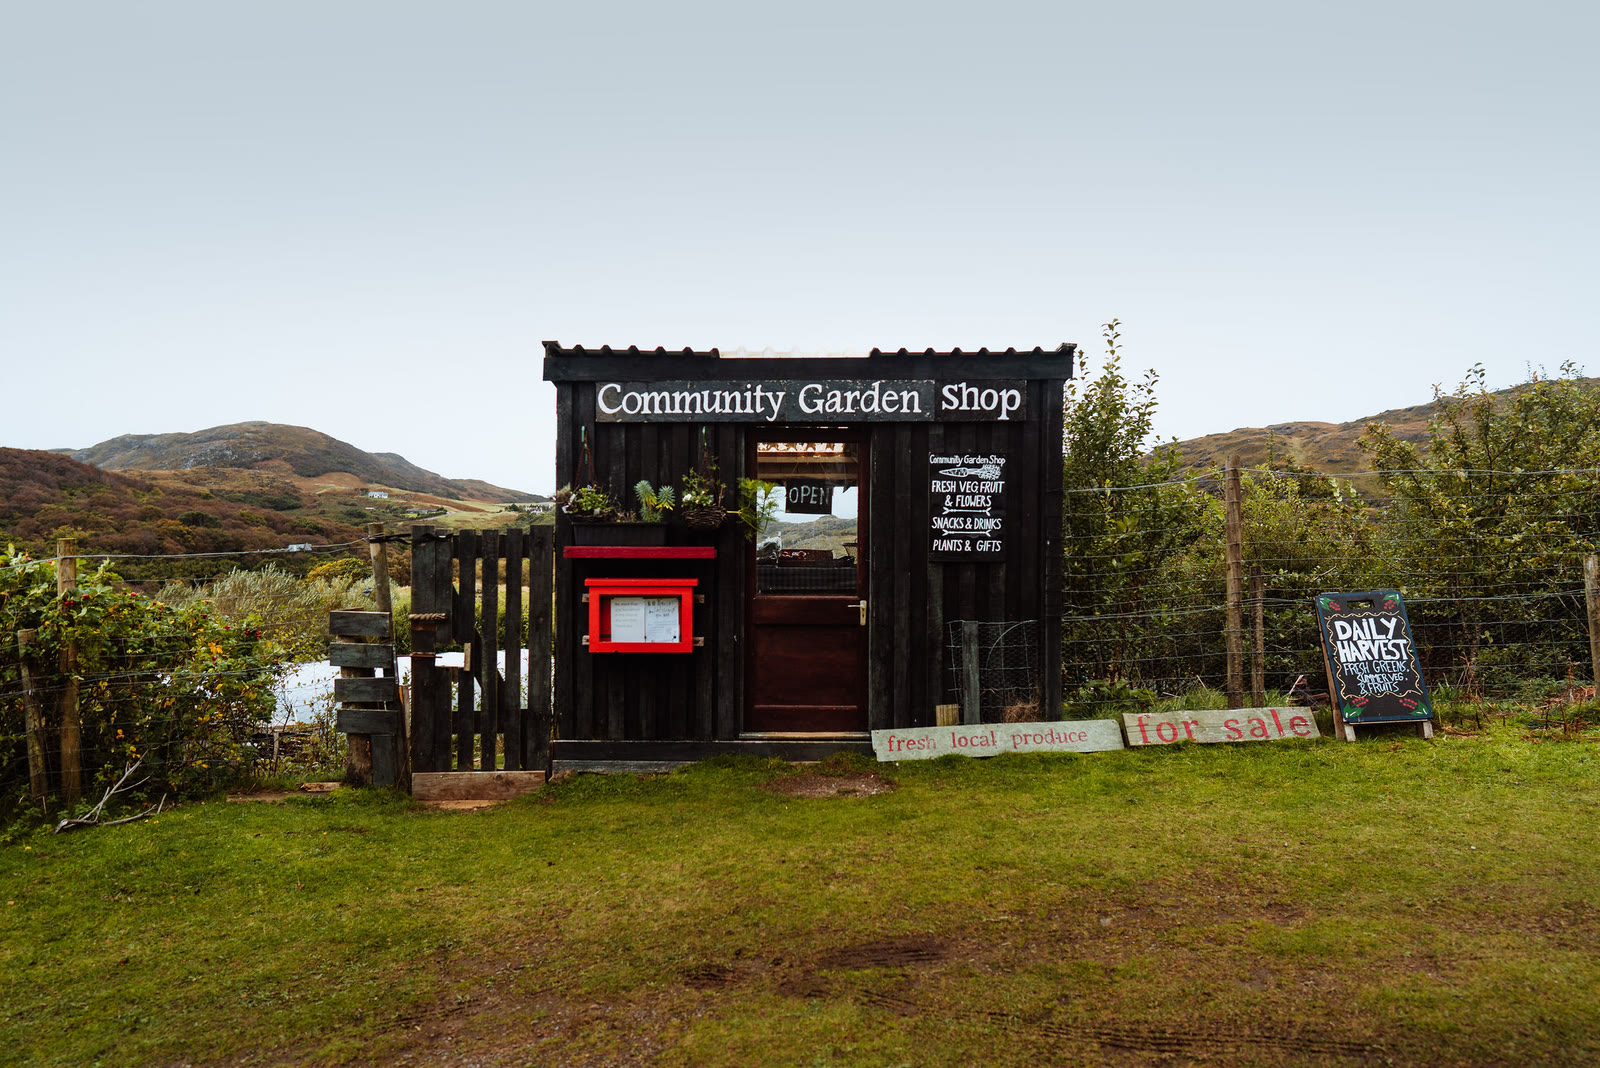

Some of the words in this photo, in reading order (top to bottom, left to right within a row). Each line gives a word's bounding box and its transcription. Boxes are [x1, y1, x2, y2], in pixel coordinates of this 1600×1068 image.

[597, 383, 786, 421] Community
[798, 382, 922, 414] Garden
[941, 382, 1021, 420] Shop
[929, 454, 963, 467] Community
[964, 454, 988, 464] Garden
[988, 454, 1006, 467] Shop
[931, 480, 956, 493] FRESH
[980, 481, 1005, 493] FRUIT
[788, 484, 830, 505] OPEN
[944, 495, 953, 506] &
[955, 495, 992, 507] FLOWERS
[931, 517, 964, 529] SNACKS
[965, 518, 972, 529] &
[974, 518, 1002, 530] DRINKS
[932, 539, 963, 551] PLANTS
[965, 540, 972, 551] &
[976, 540, 1002, 552] GIFTS
[1336, 639, 1409, 663] HARVEST
[1343, 661, 1369, 676] FRESH
[1356, 673, 1387, 684] SUMMER
[1357, 683, 1367, 695] &
[1368, 682, 1400, 693] FRUITS
[1137, 714, 1199, 744] for
[1223, 709, 1312, 742] sale
[887, 735, 938, 752] fresh
[951, 730, 997, 748] local
[1011, 728, 1088, 750] produce
